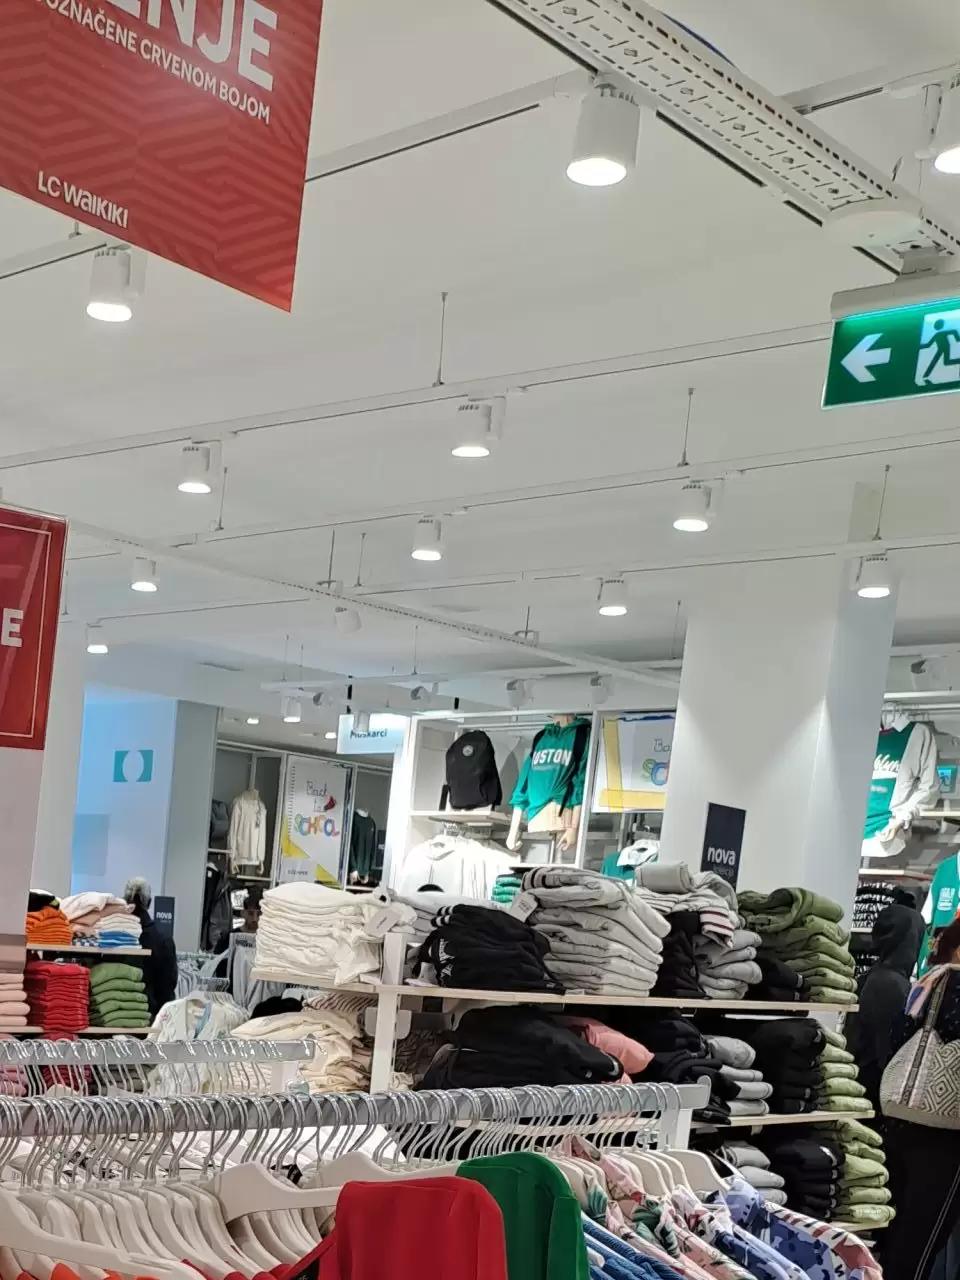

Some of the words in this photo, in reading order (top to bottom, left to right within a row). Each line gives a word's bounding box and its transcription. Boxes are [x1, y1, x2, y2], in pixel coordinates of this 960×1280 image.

[140, 39, 216, 96] CRVENOM
[219, 80, 270, 124] BOJOM
[38, 169, 61, 198] LC
[707, 846, 736, 866] nova
[156, 911, 173, 920] nova
